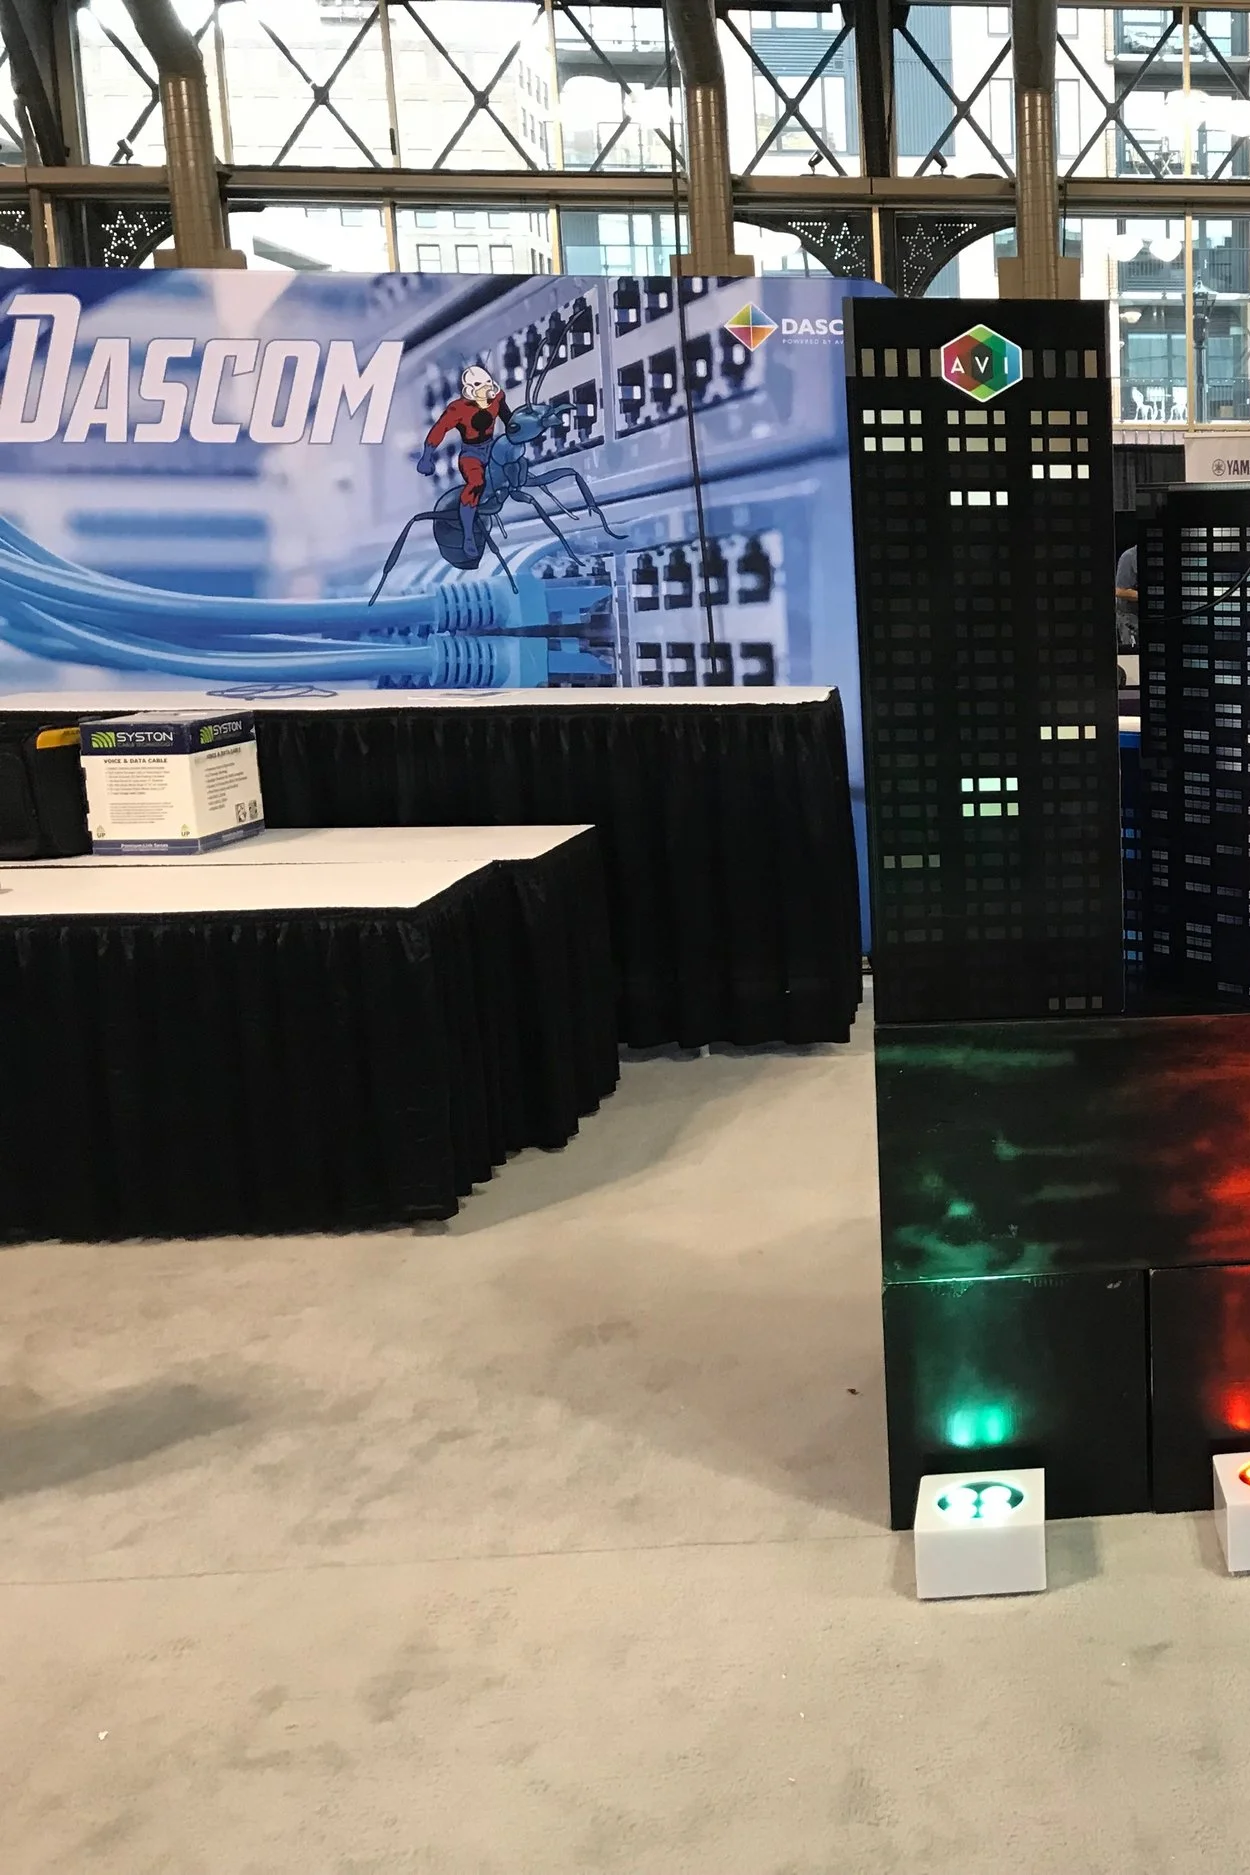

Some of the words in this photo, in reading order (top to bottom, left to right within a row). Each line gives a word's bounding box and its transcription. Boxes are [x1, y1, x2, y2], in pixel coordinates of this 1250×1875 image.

[0, 294, 404, 444] DASCOM
[951, 357, 1008, 374] AVI
[213, 721, 242, 735] SYSTON
[116, 731, 174, 742] SYSTON
